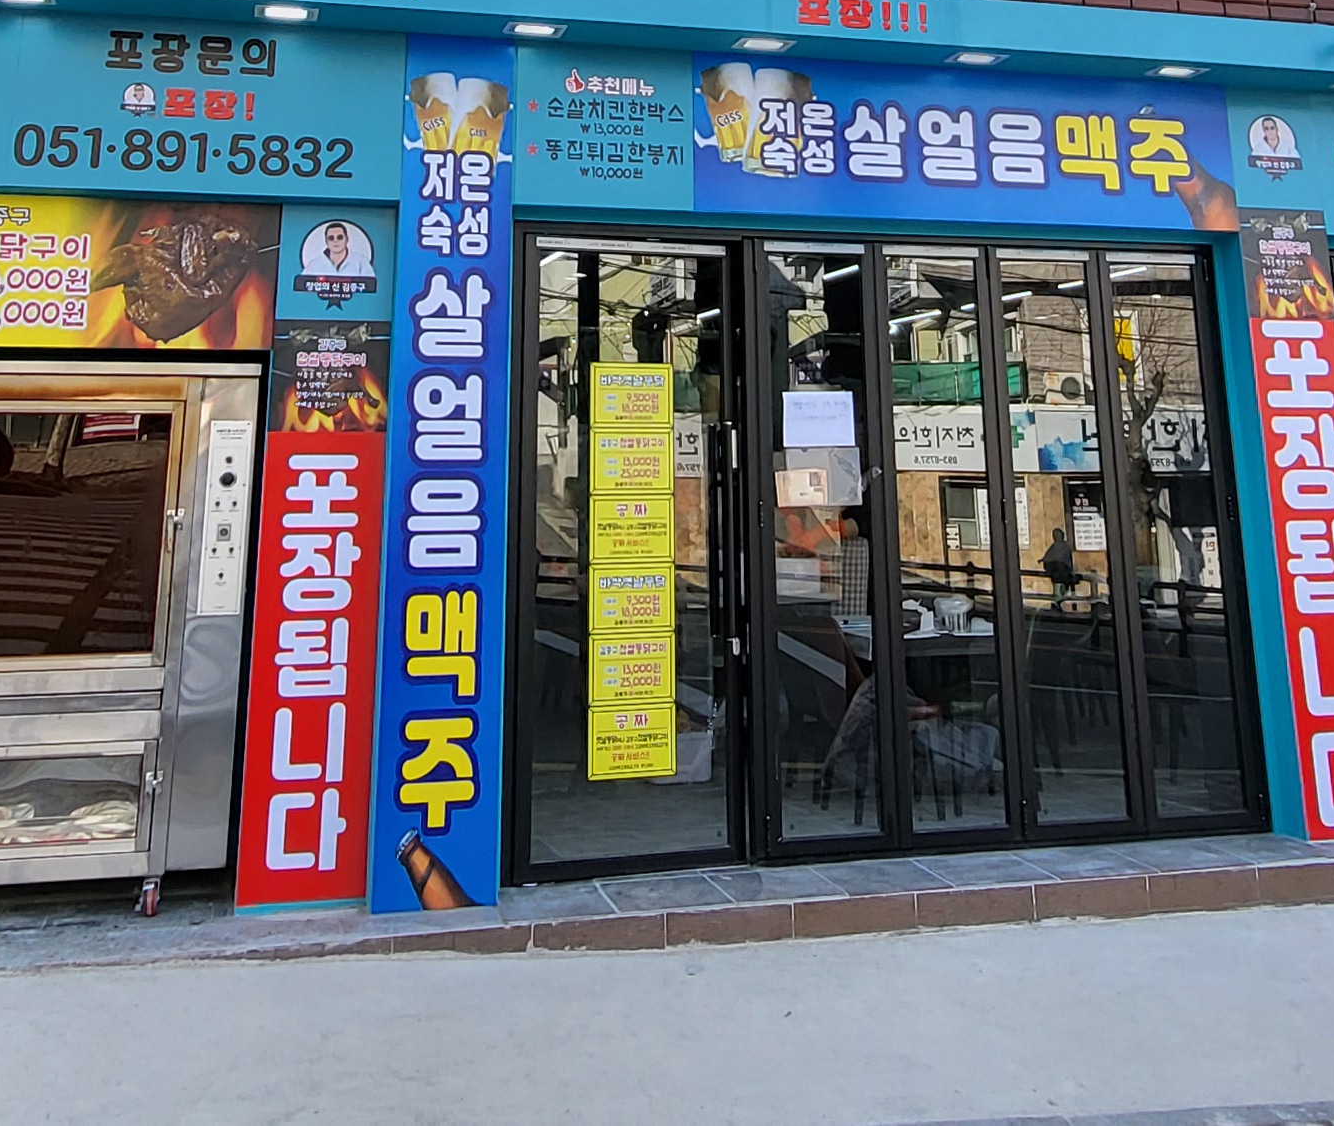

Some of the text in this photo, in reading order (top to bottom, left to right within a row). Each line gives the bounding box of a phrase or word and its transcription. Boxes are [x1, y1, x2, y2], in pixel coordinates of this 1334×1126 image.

[105, 30, 277, 77] 포장문의
[587, 75, 655, 97] 추천메뉴
[547, 97, 685, 123] 순살치킨한박스
[761, 101, 834, 138] 저온
[421, 151, 494, 202] 저온
[761, 138, 834, 175] 숙성
[421, 206, 489, 256] 숙성
[265, 453, 362, 872] 포장됩니다
